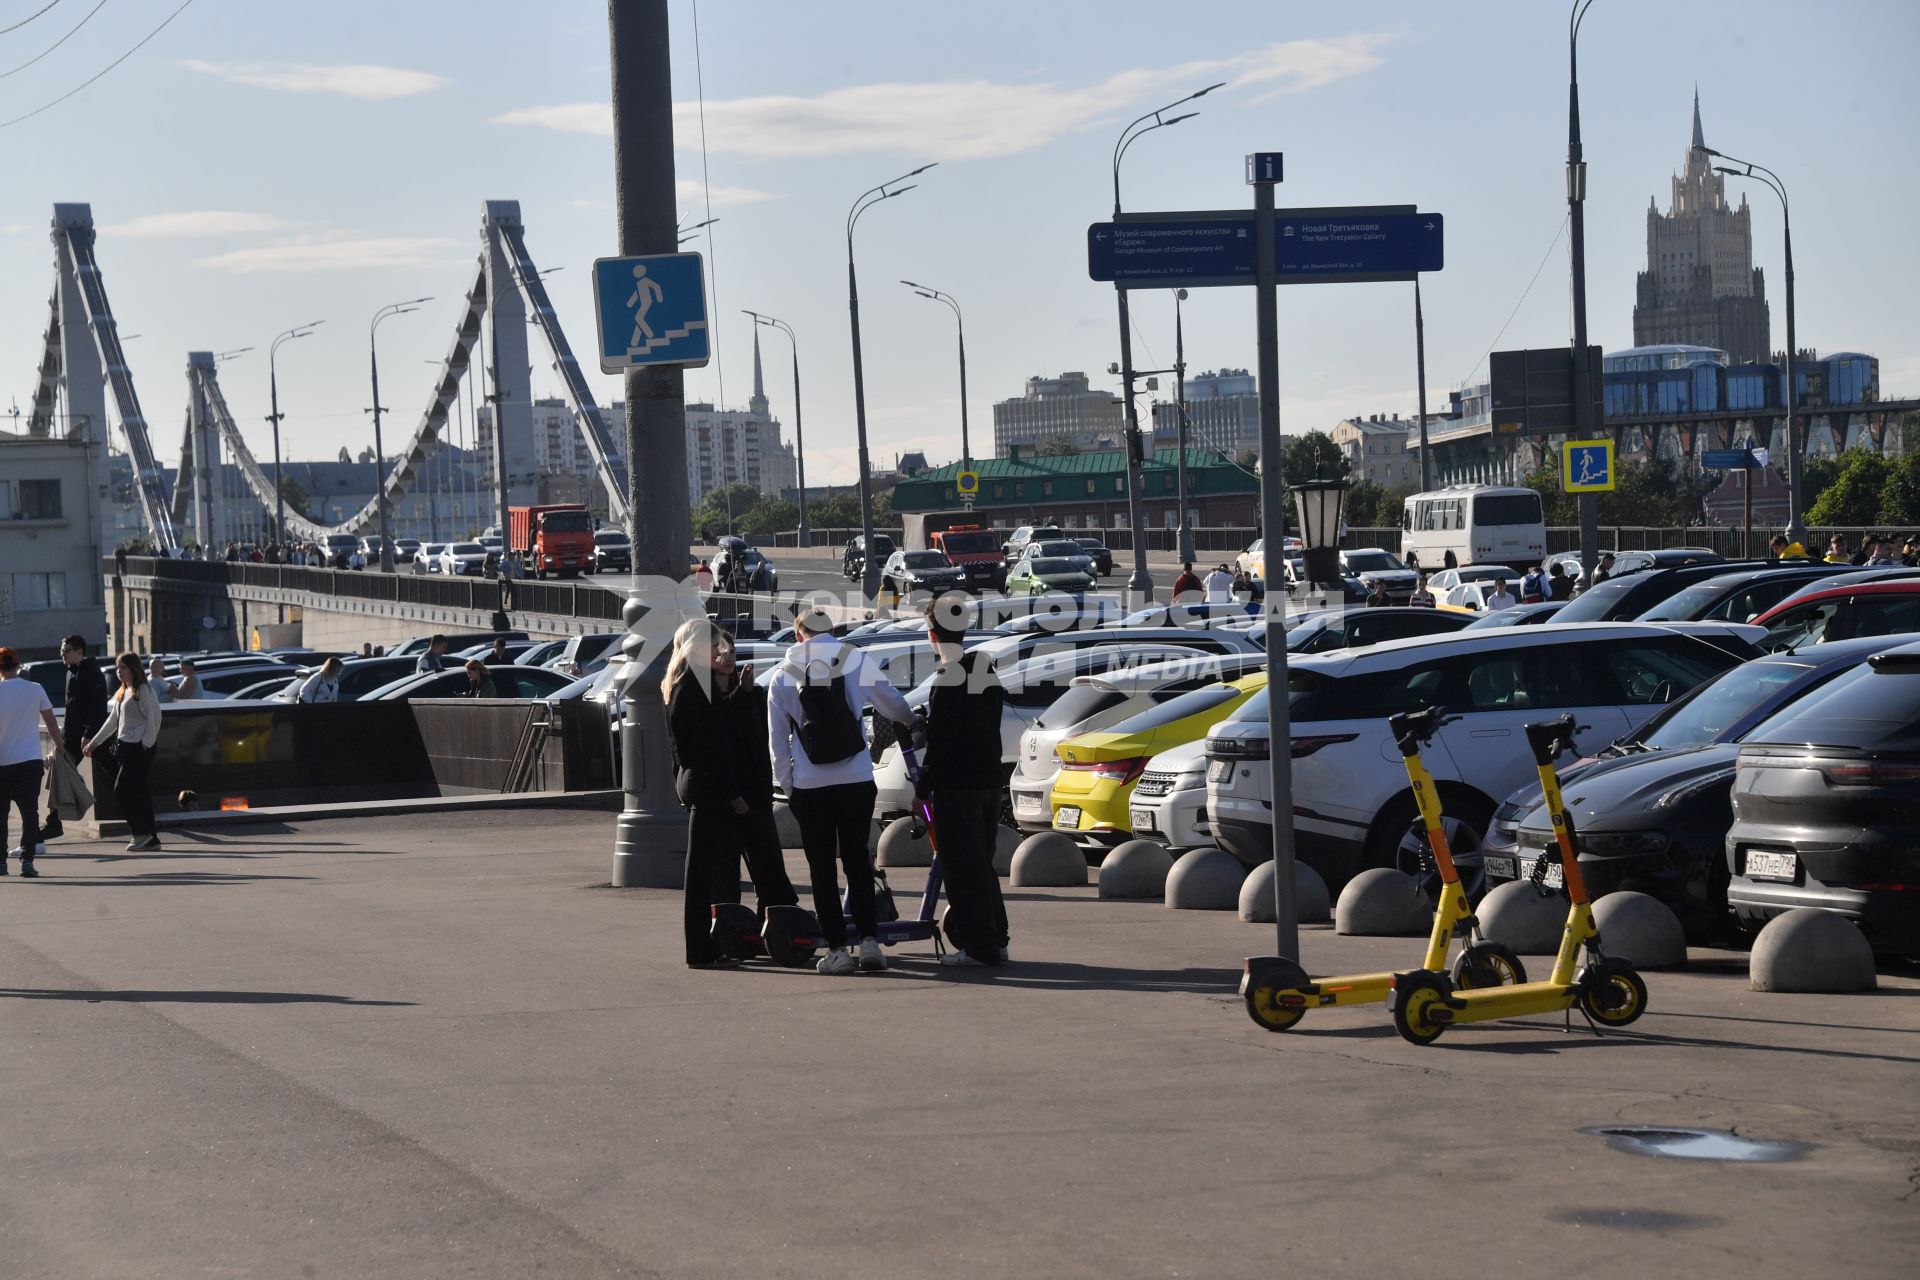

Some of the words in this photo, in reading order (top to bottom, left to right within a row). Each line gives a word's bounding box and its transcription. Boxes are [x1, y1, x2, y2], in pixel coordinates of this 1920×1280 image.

[1114, 229, 1139, 238] Музей
[1140, 229, 1194, 238] современного
[1195, 228, 1231, 237] искусства
[1302, 224, 1327, 233] Новая
[1328, 224, 1379, 234] Третьяковка
[1114, 238, 1146, 246] «Гараж»
[1330, 234, 1362, 242] Tretyakov
[1363, 233, 1386, 241] Gallery
[1114, 247, 1135, 255] Garage
[1171, 246, 1213, 254] Contemporary
